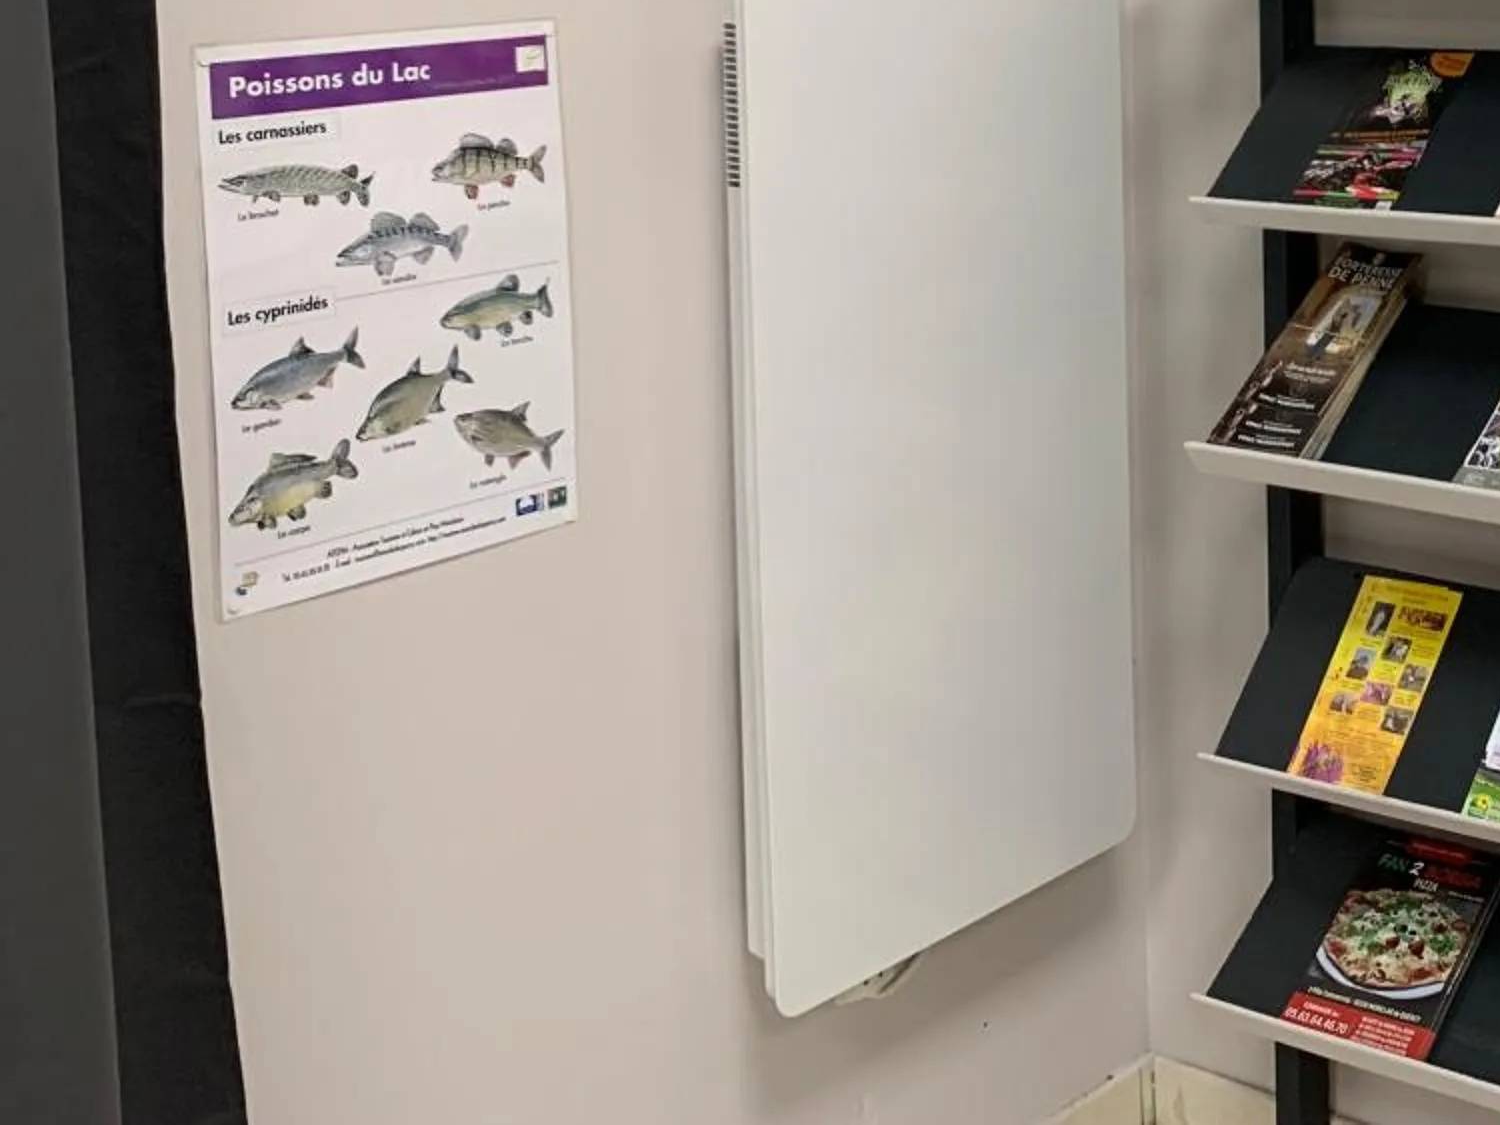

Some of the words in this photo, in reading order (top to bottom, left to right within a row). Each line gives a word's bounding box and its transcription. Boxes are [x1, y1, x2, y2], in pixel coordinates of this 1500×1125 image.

[229, 72, 343, 100] Poissons
[351, 64, 383, 87] du
[391, 62, 432, 83] Lac
[218, 129, 241, 145] Les
[245, 120, 327, 143] carnassiers
[227, 308, 251, 326] Les
[255, 294, 329, 323] cyprinidés
